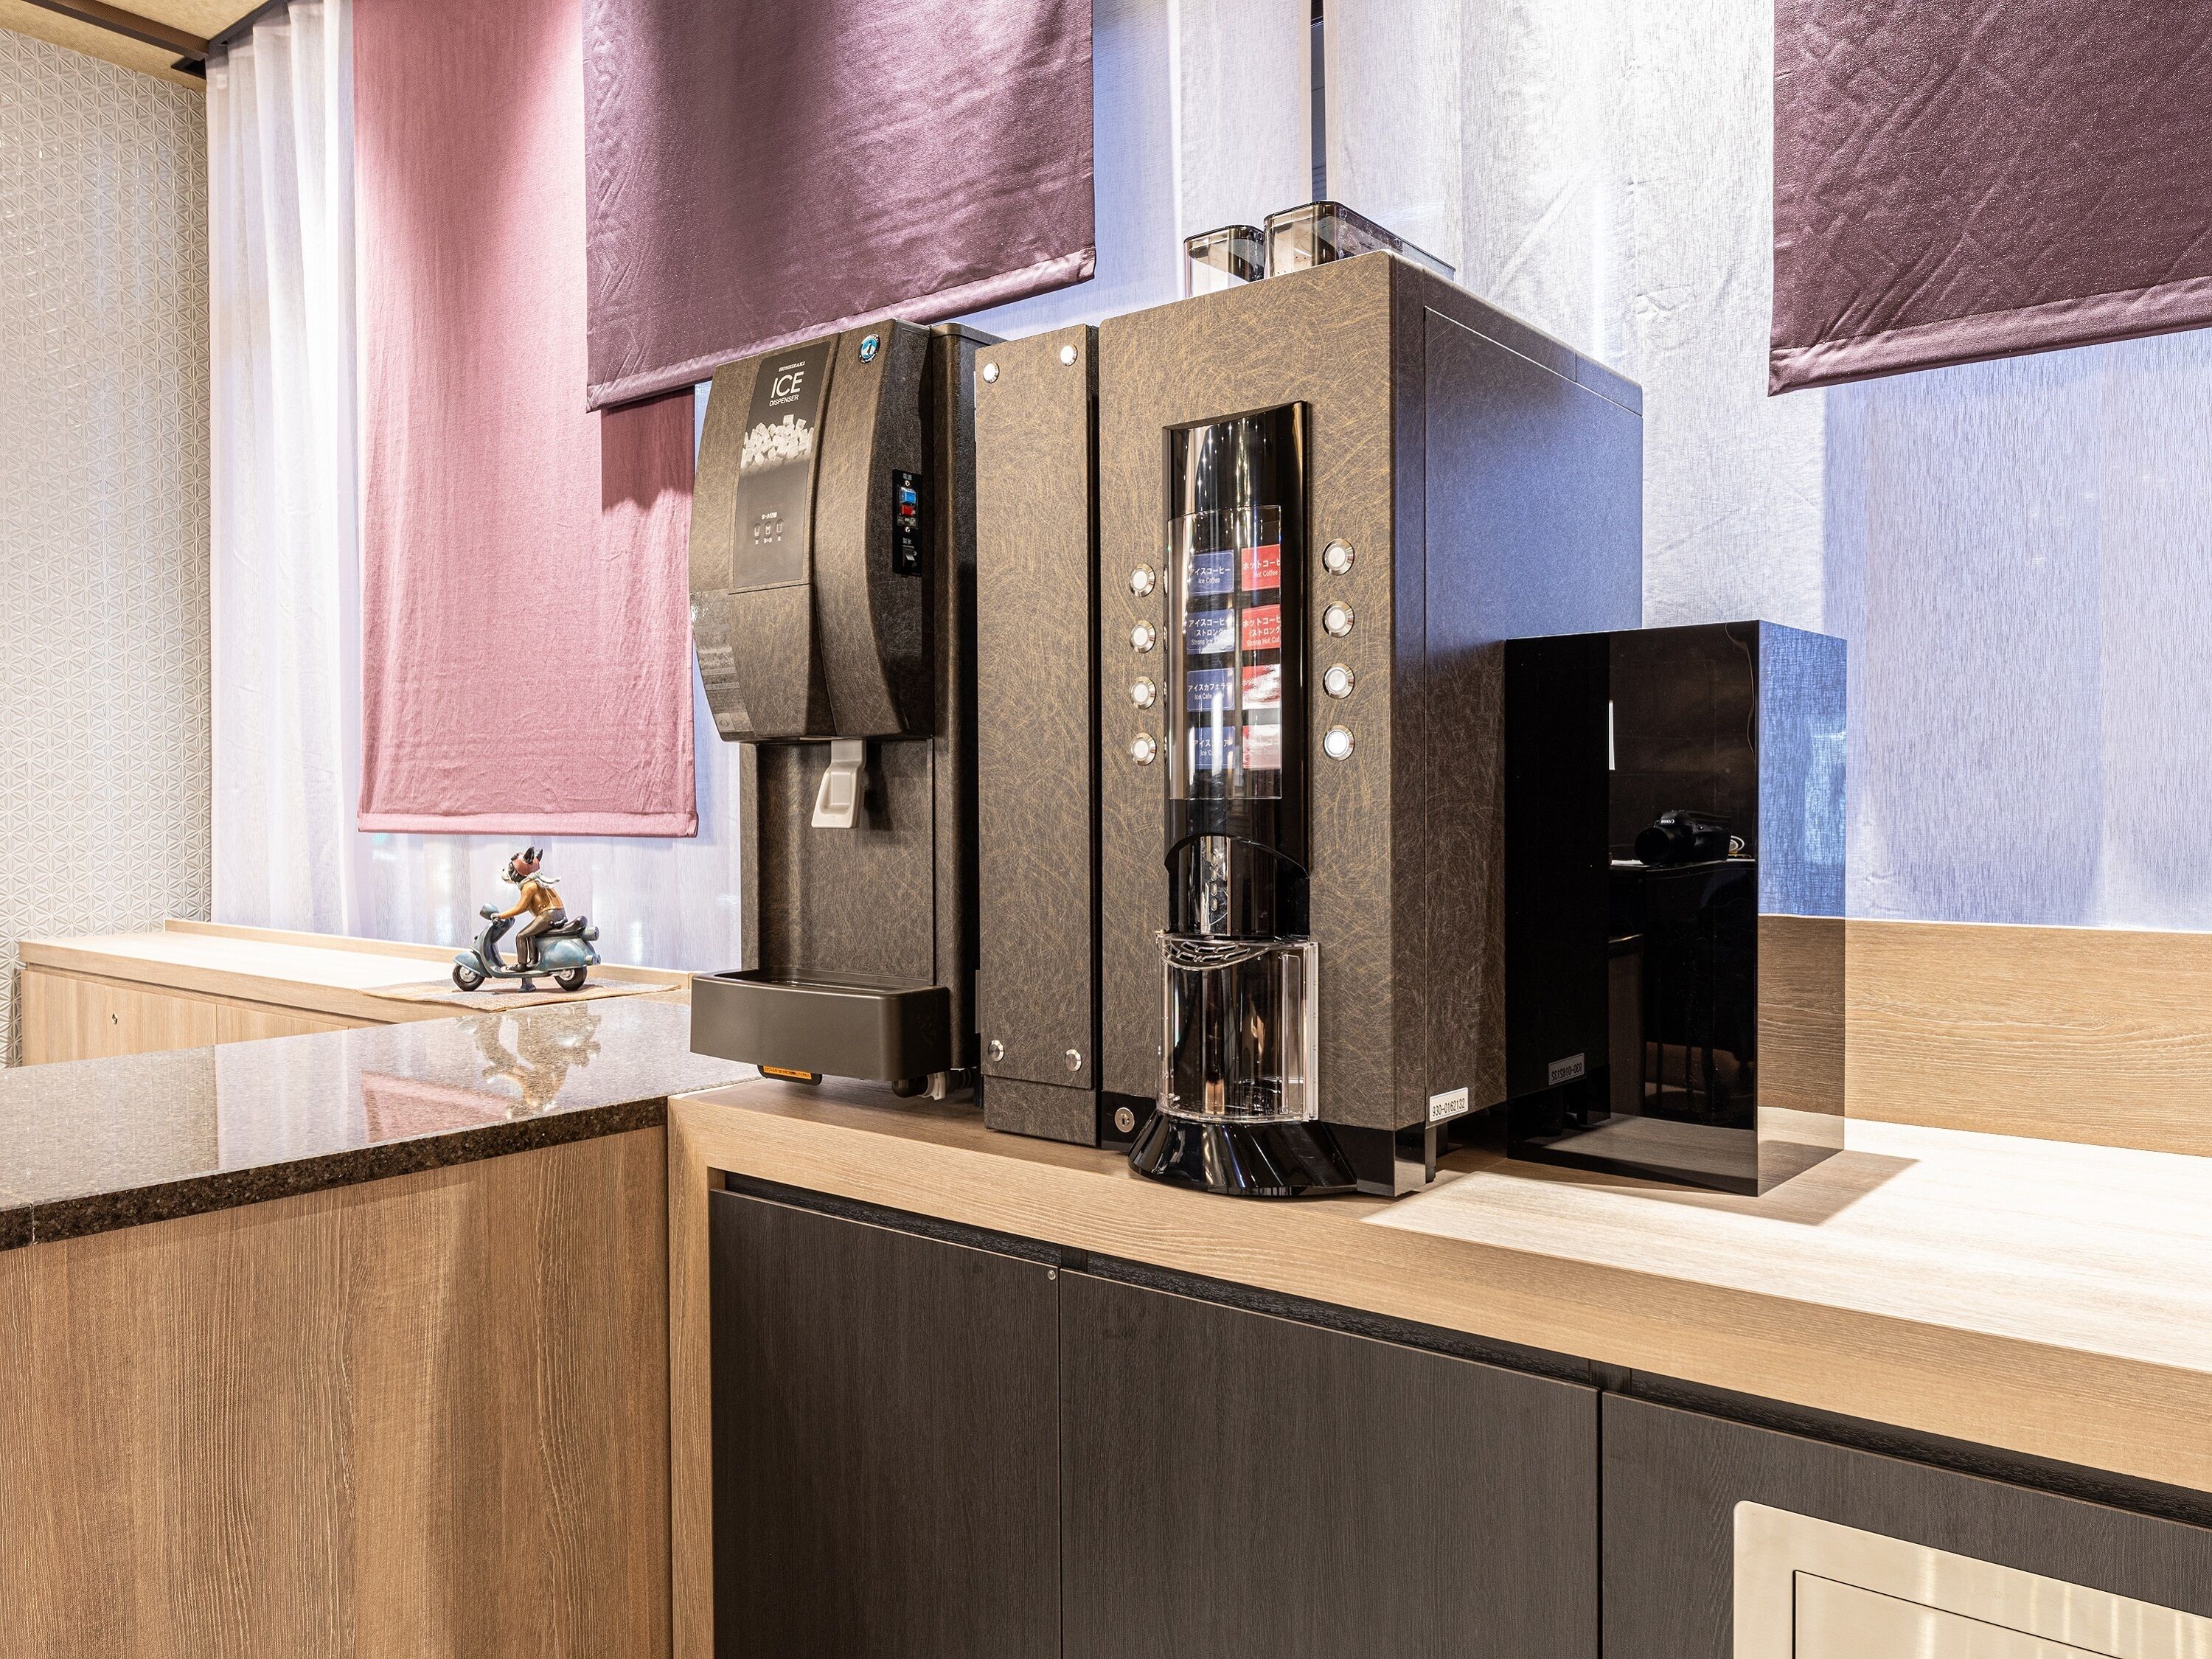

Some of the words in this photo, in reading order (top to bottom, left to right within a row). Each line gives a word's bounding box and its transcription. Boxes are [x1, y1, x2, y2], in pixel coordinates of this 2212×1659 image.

[779, 361, 806, 372] HOSHIZAKI
[771, 371, 804, 398] ICE
[769, 394, 799, 407] DISPENSER
[1262, 569, 1279, 577] Coffee
[1246, 639, 1262, 647] Strong
[1432, 1097, 1465, 1117] 930-0162132
